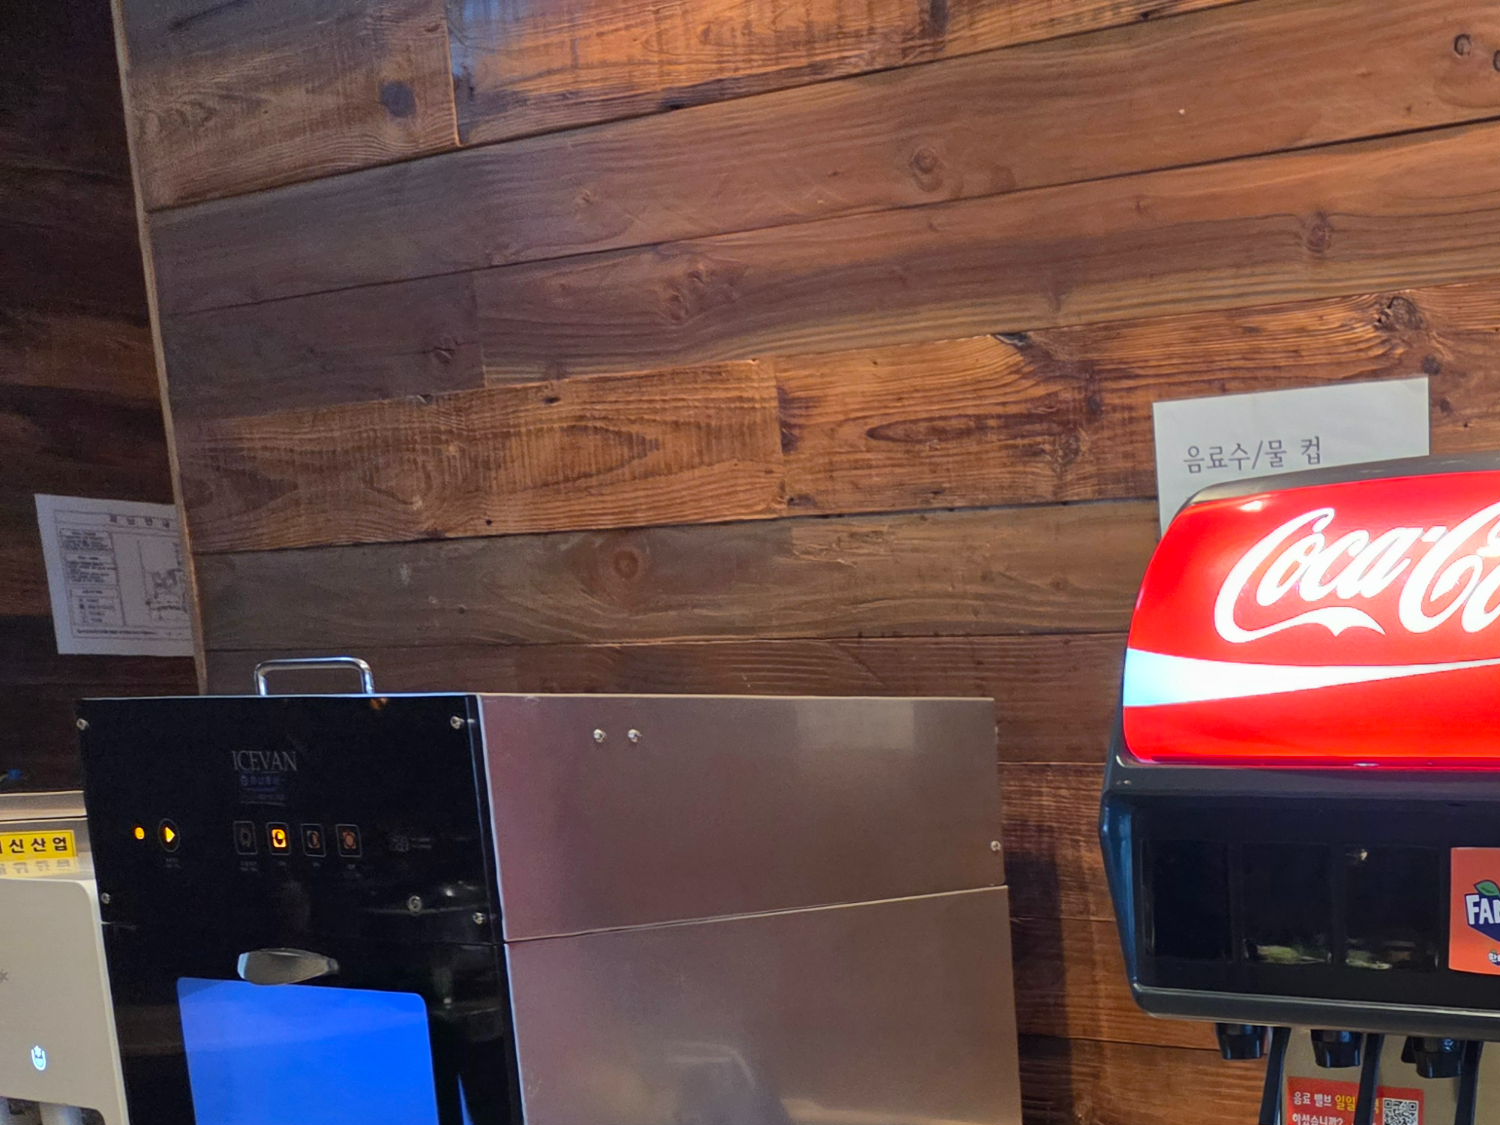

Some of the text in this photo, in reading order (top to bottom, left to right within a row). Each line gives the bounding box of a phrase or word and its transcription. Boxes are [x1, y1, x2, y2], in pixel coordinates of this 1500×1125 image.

[1183, 436, 1321, 474] 음료수/물 컵
[231, 750, 298, 772] ICEVAN
[1314, 1093, 1332, 1107] 밸브
